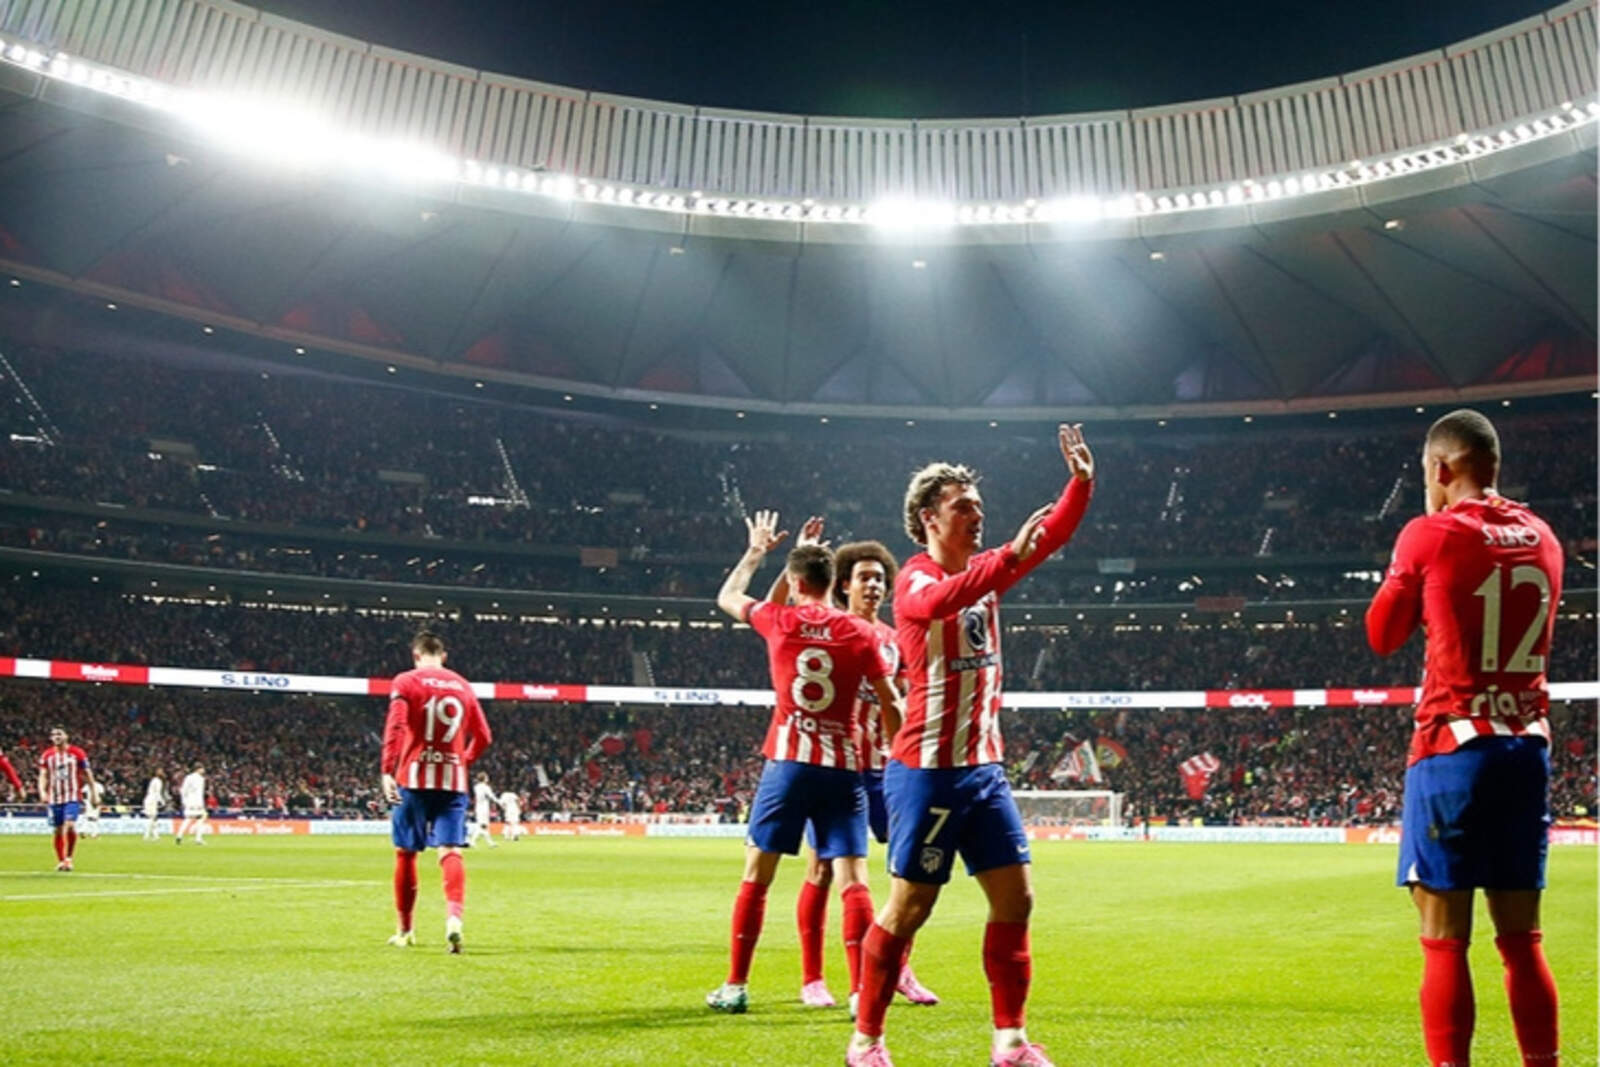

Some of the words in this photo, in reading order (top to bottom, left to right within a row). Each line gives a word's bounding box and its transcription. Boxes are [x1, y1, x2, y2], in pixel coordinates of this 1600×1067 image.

[1472, 564, 1550, 672] 12
[243, 675, 290, 688] LINO
[792, 647, 835, 712] 8
[1470, 684, 1519, 717] ria
[423, 694, 465, 743] 19
[924, 807, 951, 844] 7
